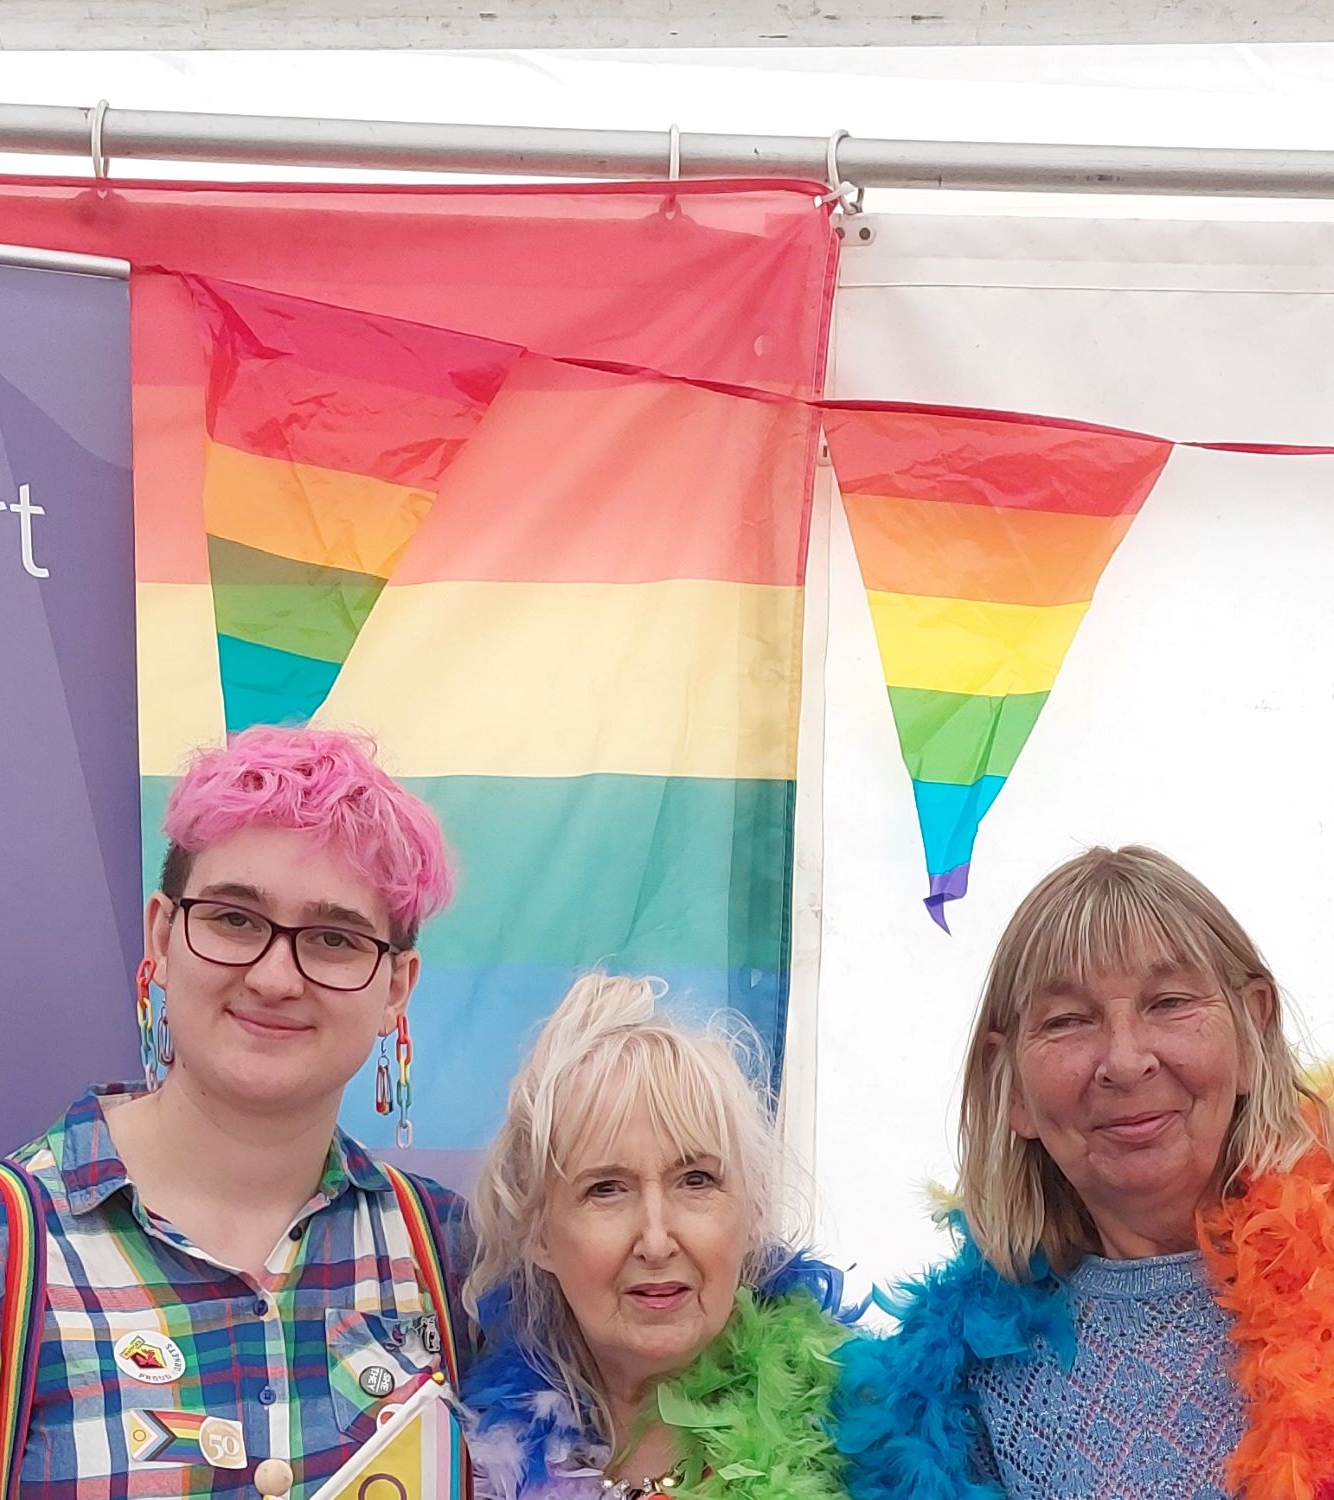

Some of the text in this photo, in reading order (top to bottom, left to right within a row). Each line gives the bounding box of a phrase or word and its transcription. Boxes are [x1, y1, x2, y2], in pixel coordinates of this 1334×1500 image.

[367, 1367, 379, 1392] THEY
[380, 1371, 389, 1392] SHE
[208, 1433, 240, 1461] 50
